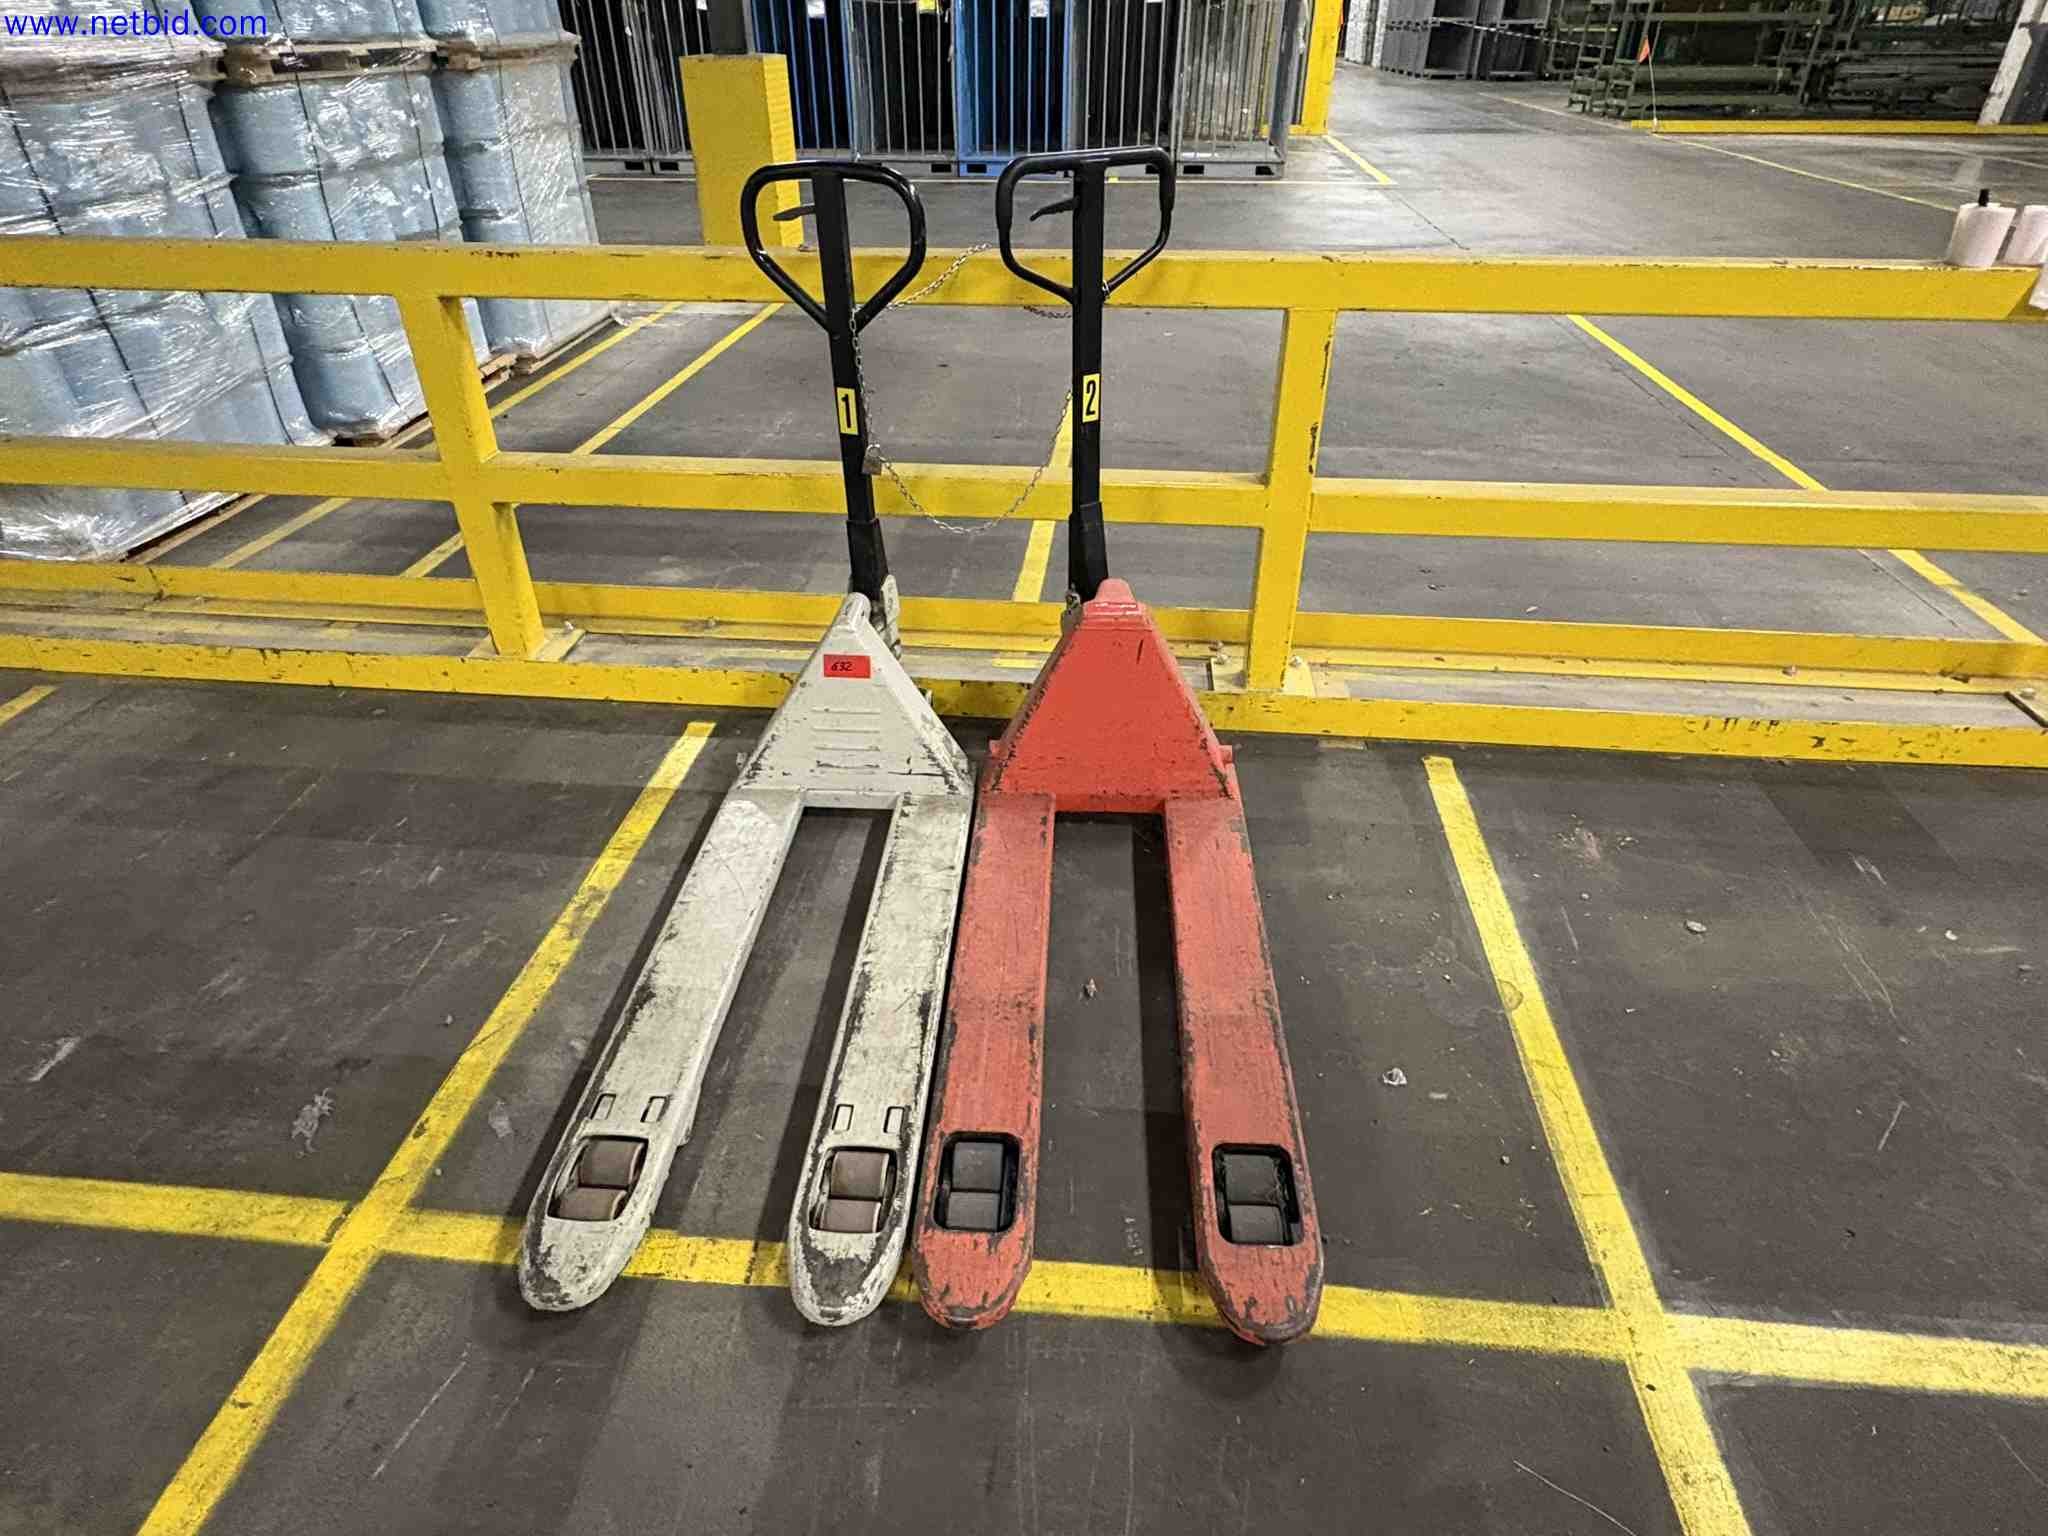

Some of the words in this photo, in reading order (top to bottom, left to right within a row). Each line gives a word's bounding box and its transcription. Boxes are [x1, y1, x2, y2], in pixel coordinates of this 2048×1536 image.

[841, 393, 851, 428] 1
[1086, 379, 1096, 416] 2
[831, 661, 853, 671] 632
